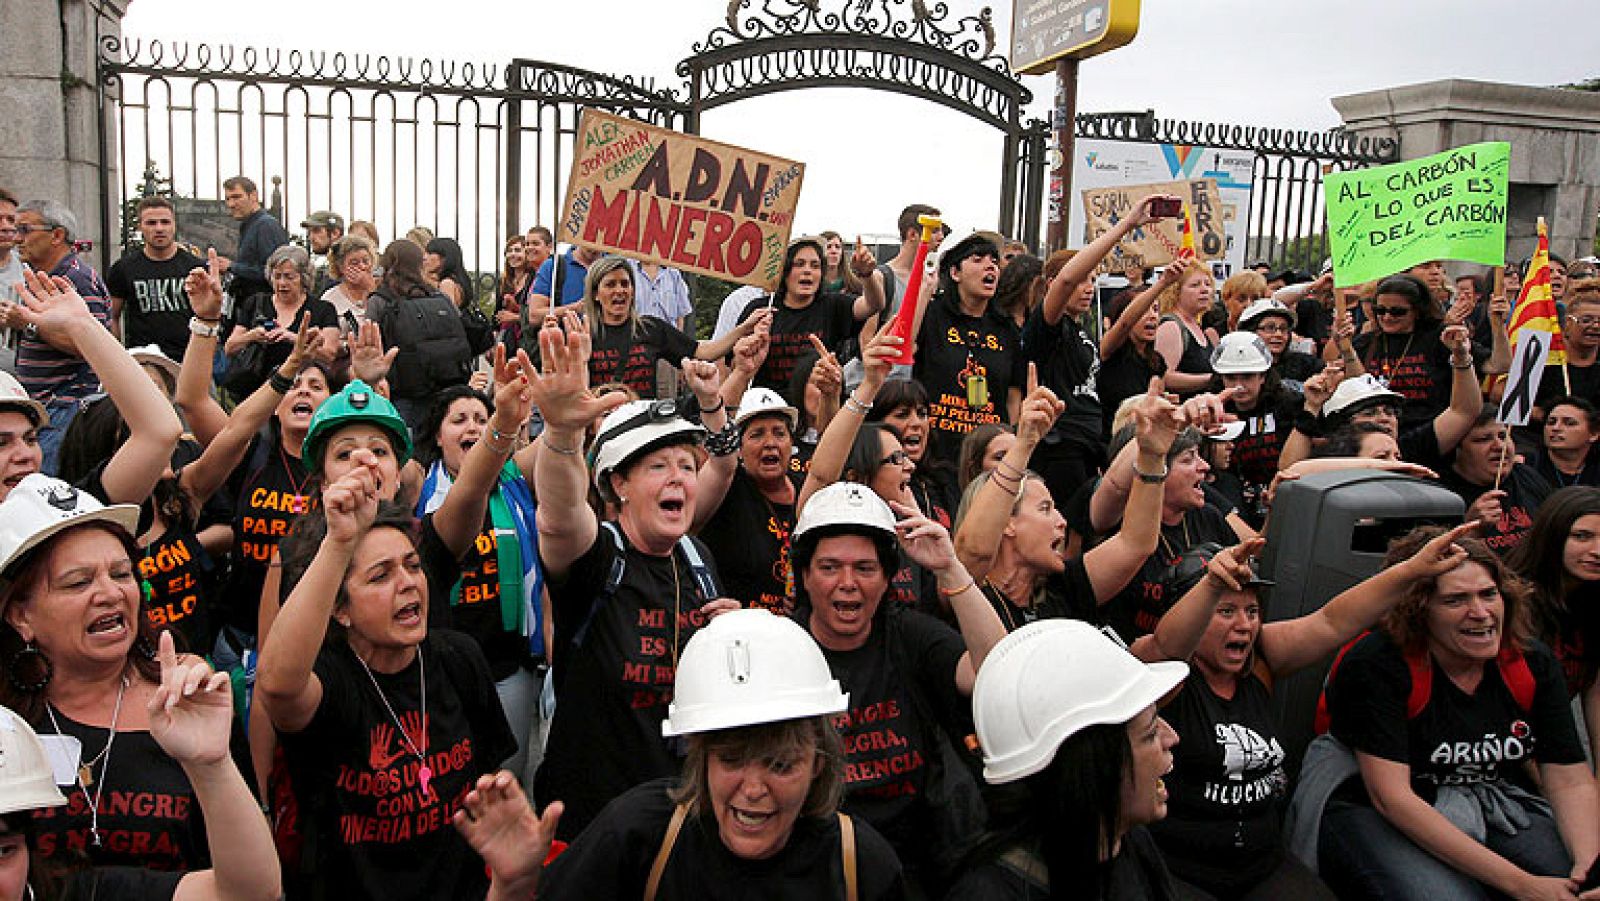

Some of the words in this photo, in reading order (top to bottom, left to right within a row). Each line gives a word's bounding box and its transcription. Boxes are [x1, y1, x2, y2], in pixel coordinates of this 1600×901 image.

[631, 139, 770, 222] A.D.N.
[1339, 181, 1371, 203] AL
[1387, 152, 1477, 193] CARBÓN
[1374, 200, 1403, 220] LO
[1413, 184, 1454, 209] QUE
[1468, 178, 1495, 194] ES
[583, 185, 763, 278] MINERO
[1370, 221, 1416, 247] DEL
[1425, 199, 1505, 227] CARBÓN
[638, 608, 666, 628] MI
[641, 636, 666, 657] ES
[623, 661, 651, 684] MI
[840, 728, 909, 755] EGRA,
[1430, 733, 1525, 764] ARIÑO
[66, 792, 191, 820] SANGRE
[377, 792, 414, 817] CON
[416, 808, 440, 835] DE
